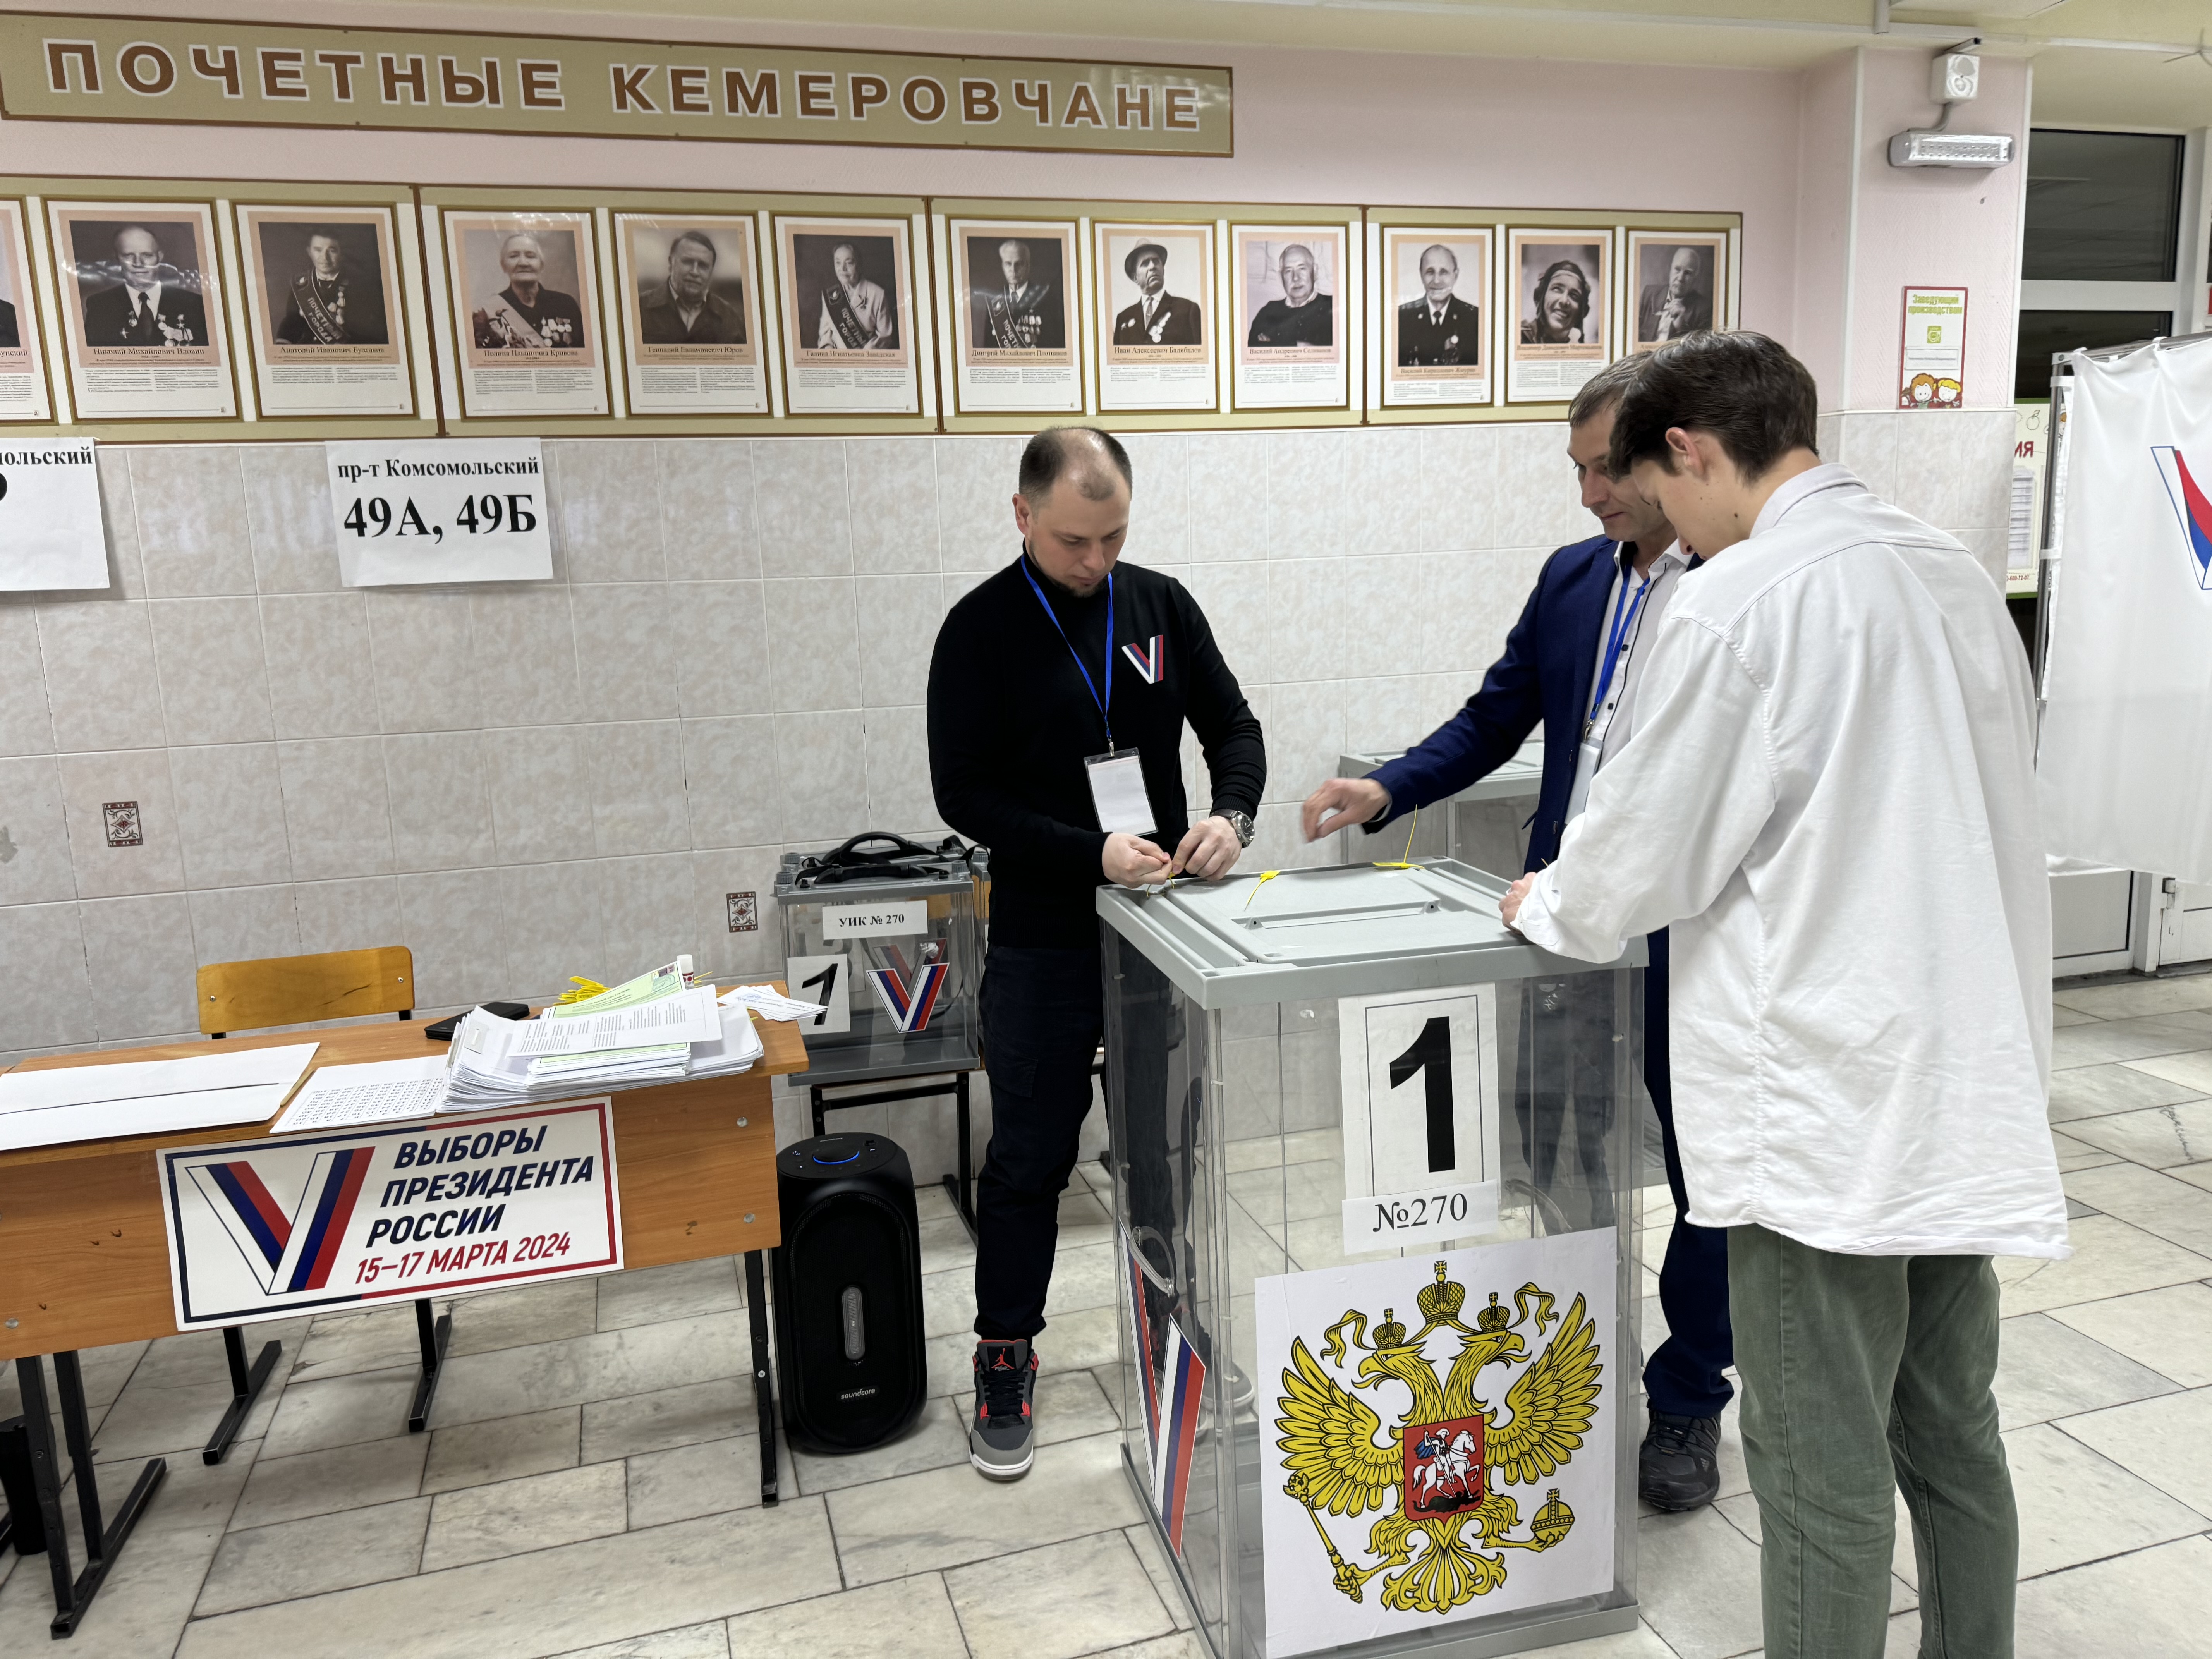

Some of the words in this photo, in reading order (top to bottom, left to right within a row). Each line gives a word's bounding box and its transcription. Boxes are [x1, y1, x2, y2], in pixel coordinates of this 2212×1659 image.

[42, 38, 565, 111] ПОЧЕТНЫЕ
[609, 63, 1201, 132] КЕМЕРОВЧАНЕ
[0, 349, 27, 357] унский
[338, 461, 379, 480] пр-т
[386, 457, 539, 477] Комсомольский
[344, 496, 443, 545] 49А,
[456, 494, 537, 535] 49Б
[838, 916, 867, 927] УИК
[870, 915, 883, 925] №
[886, 914, 905, 924] 270
[802, 963, 838, 1025] 1
[1389, 1016, 1455, 1173] 1
[395, 1125, 547, 1169] ВЫБОРЫ
[380, 1156, 592, 1208] ПРЕЗИДЕНТА
[366, 1204, 507, 1248] РОССИИ
[1372, 1193, 1468, 1232] №270
[426, 1240, 508, 1274] МАРТА
[512, 1232, 571, 1263] 2024
[841, 1387, 876, 1400] soundcore
